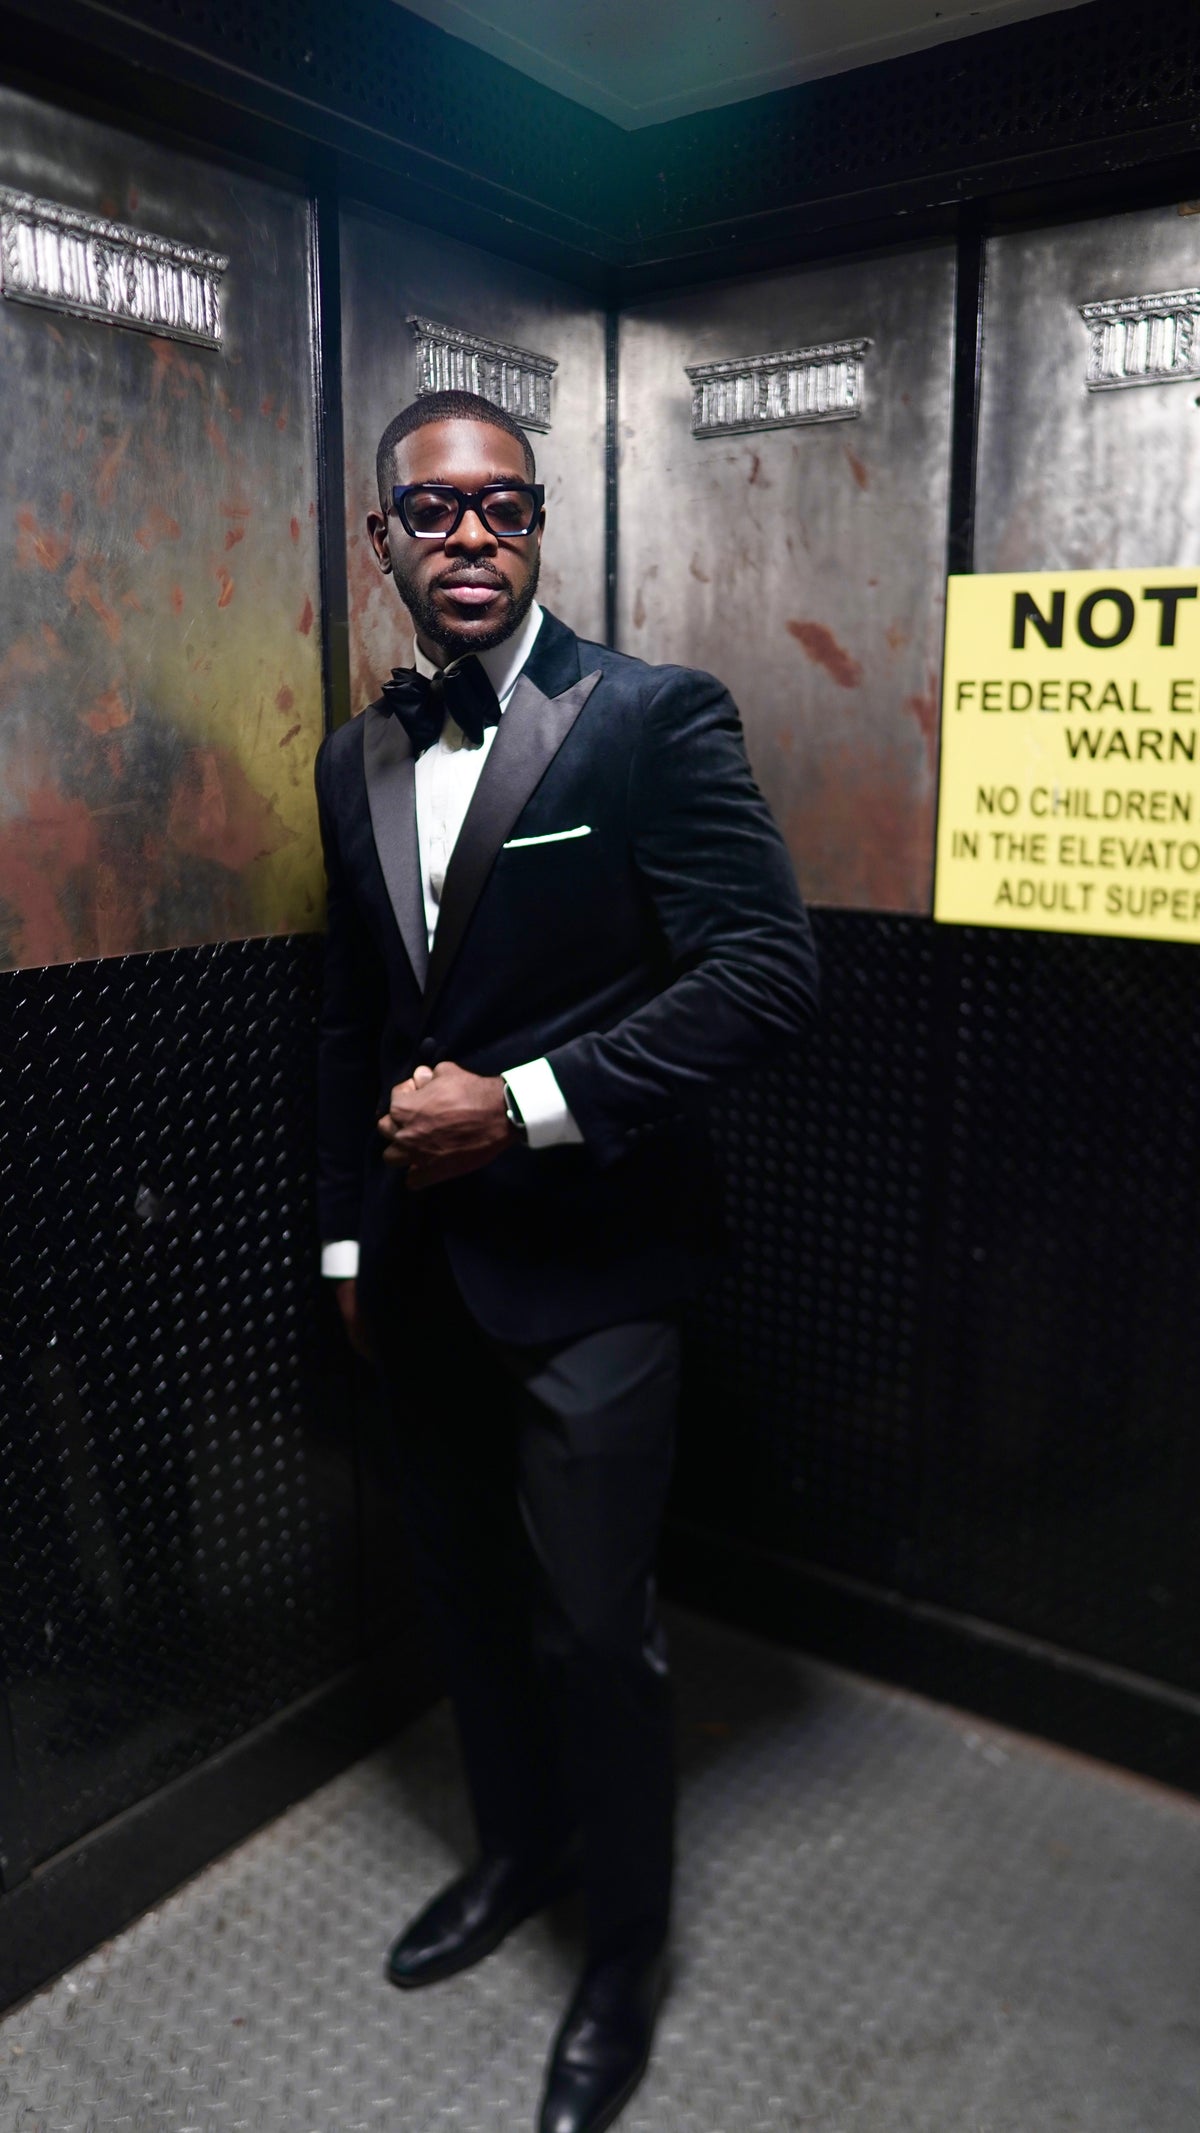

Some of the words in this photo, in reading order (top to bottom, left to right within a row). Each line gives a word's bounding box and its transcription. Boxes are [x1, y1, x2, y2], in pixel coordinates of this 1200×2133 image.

[1010, 586, 1198, 650] NOT
[955, 679, 1151, 713] FEDERAL
[1169, 681, 1200, 715] E
[1065, 729, 1195, 761] WARN
[975, 785, 1019, 816] NO
[1029, 787, 1190, 823] CHILDREN
[952, 831, 980, 859] IN
[989, 833, 1047, 865] THE
[1057, 836, 1200, 874] ELEVATO
[994, 879, 1096, 915] ADULT
